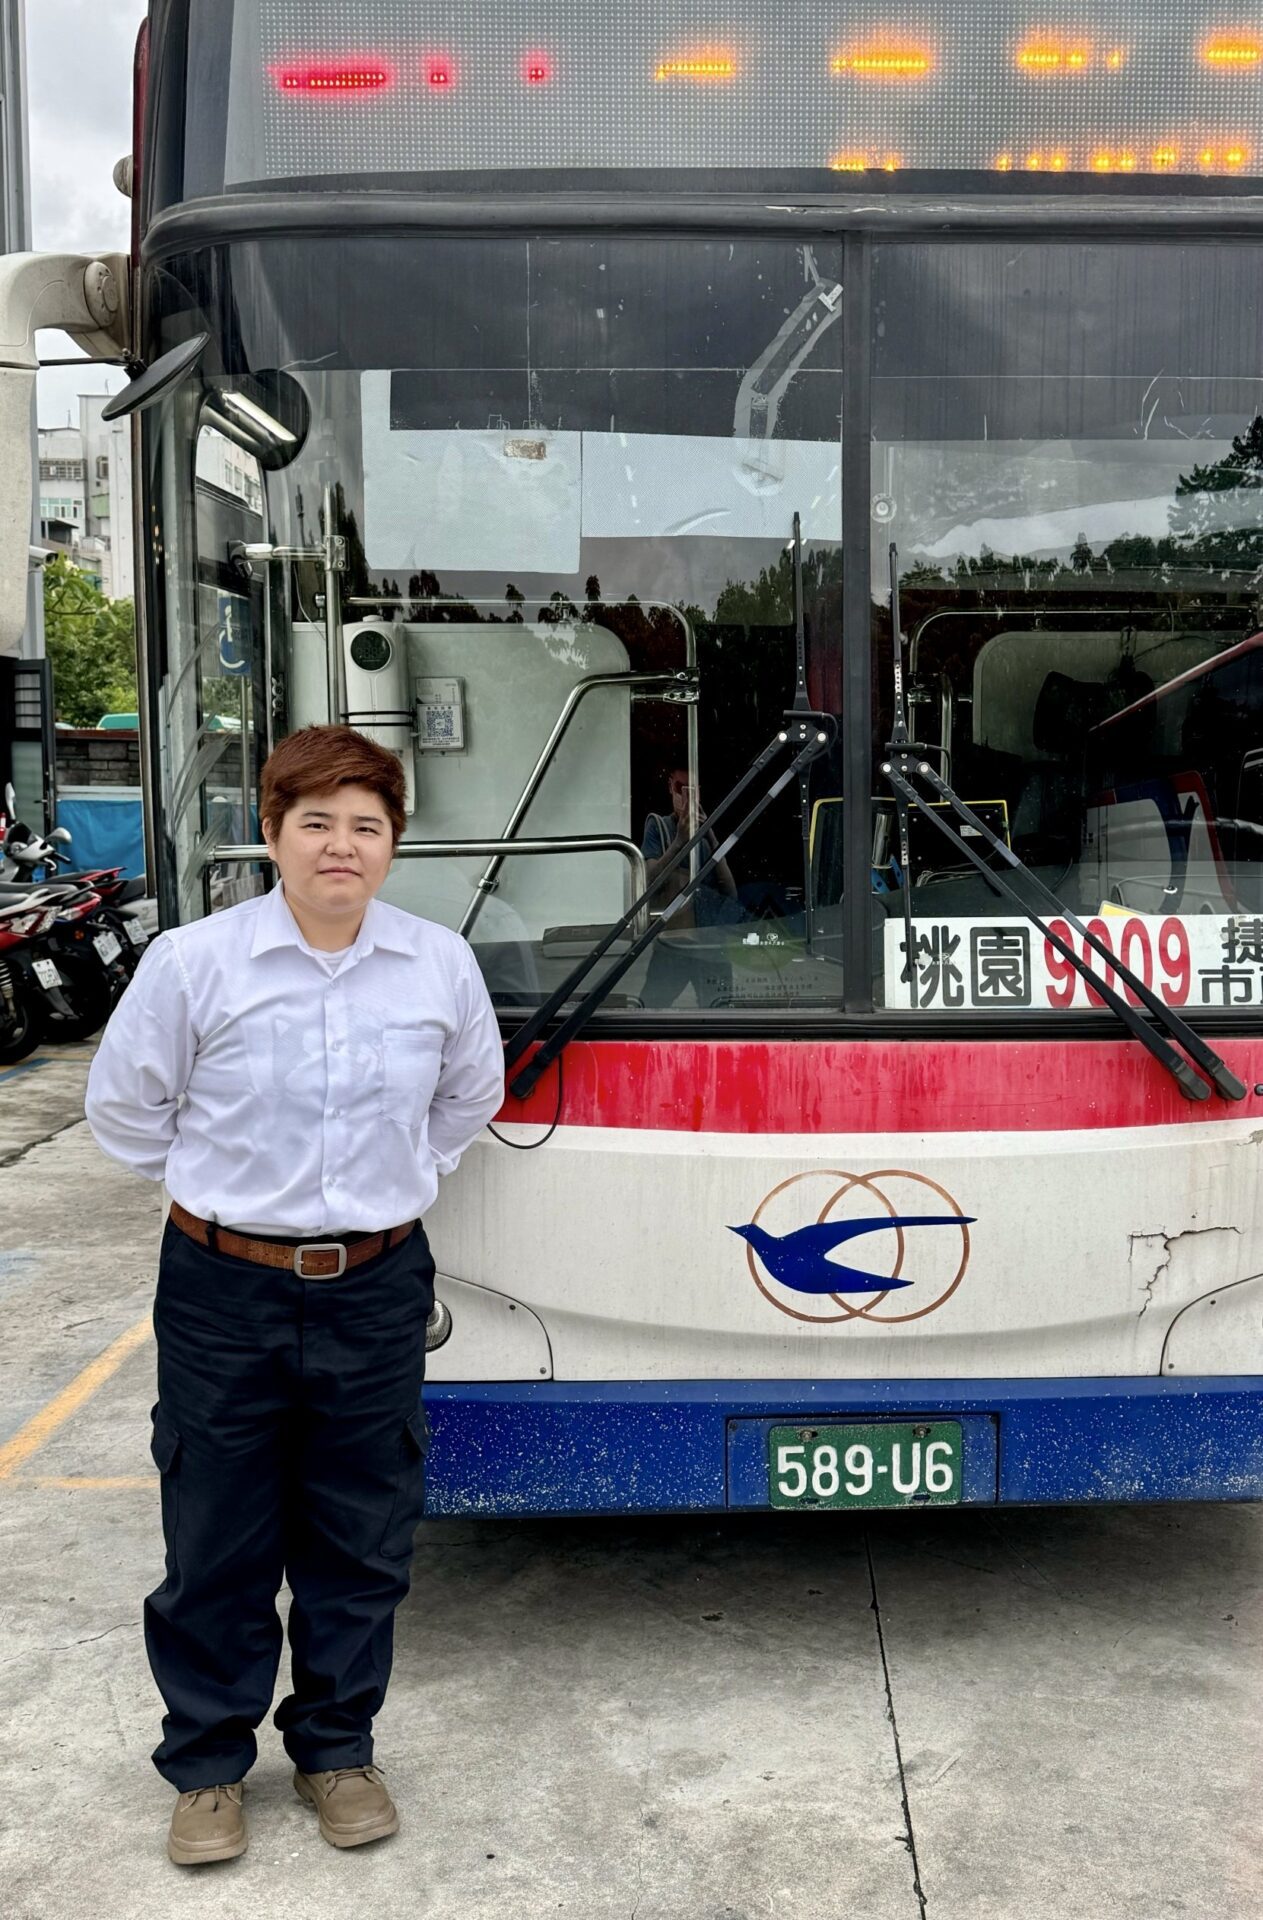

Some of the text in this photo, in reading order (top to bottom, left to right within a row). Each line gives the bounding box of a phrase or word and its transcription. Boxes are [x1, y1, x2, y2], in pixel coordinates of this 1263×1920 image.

[900, 917, 1191, 1009] 桃園 9009
[1198, 965, 1263, 1005] 市
[777, 1442, 953, 1497] 589-U6
